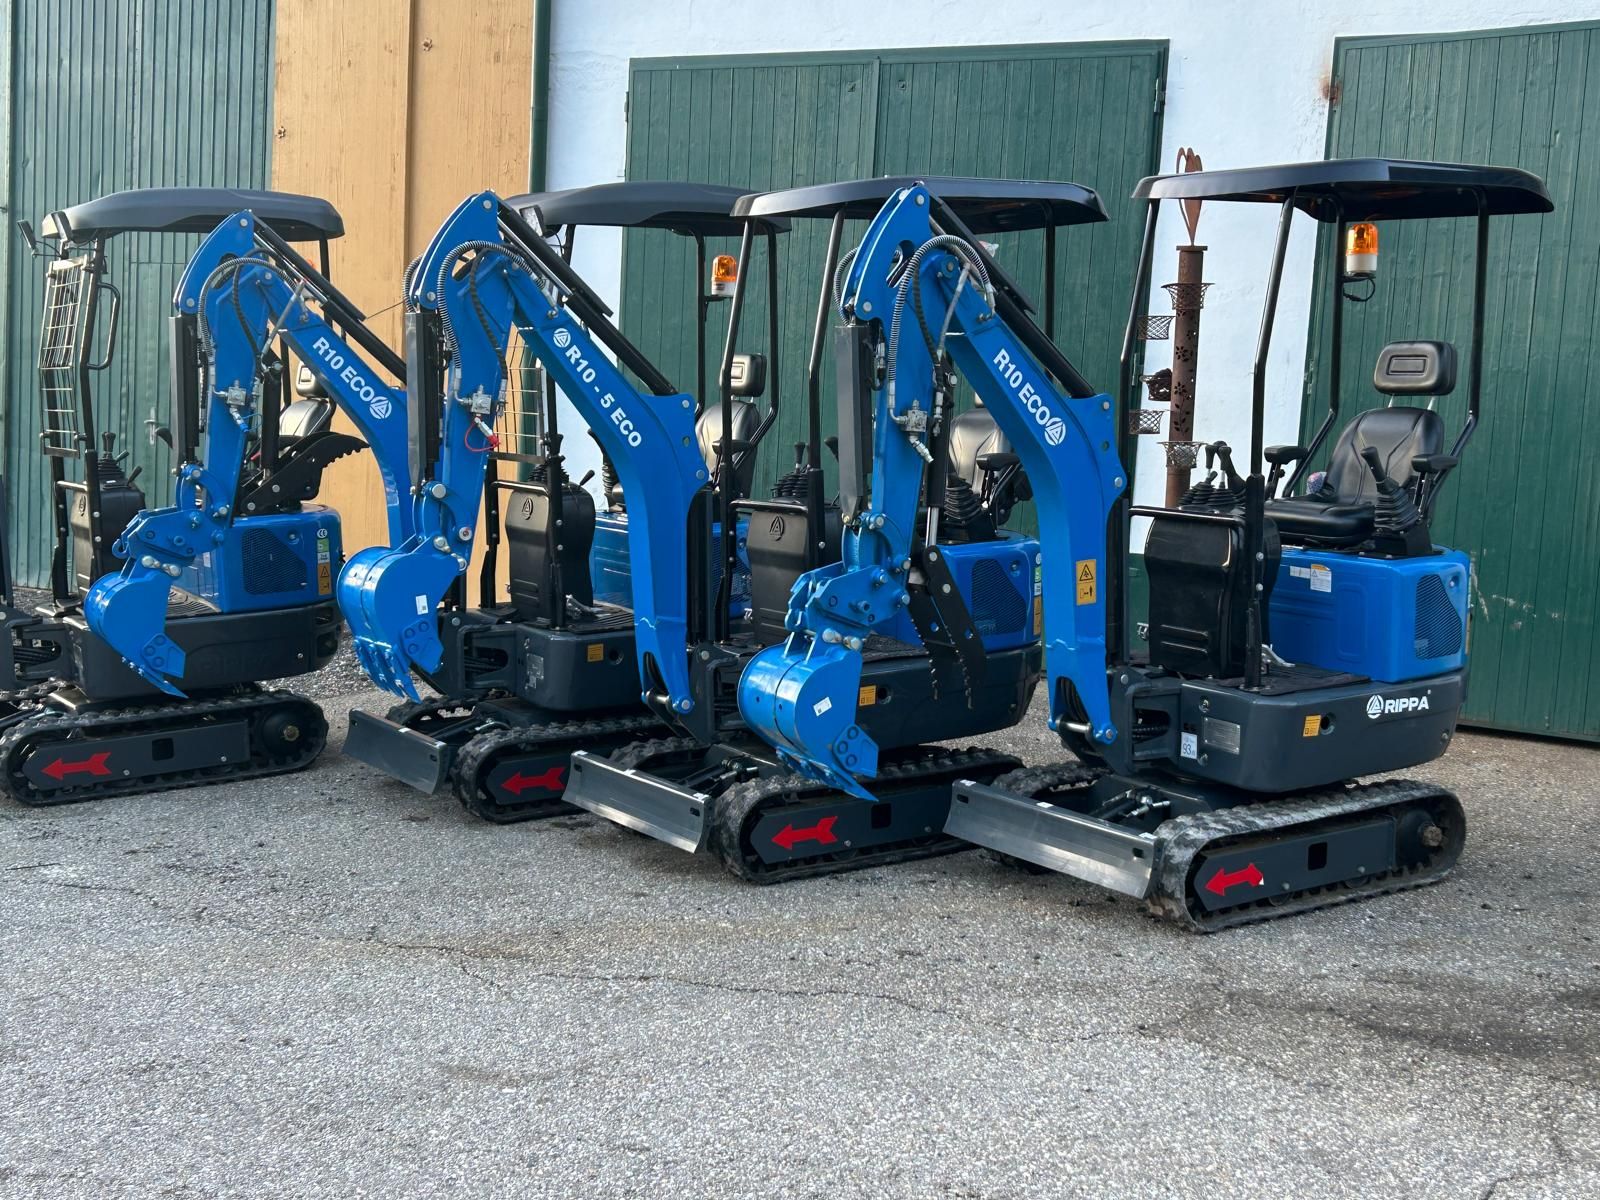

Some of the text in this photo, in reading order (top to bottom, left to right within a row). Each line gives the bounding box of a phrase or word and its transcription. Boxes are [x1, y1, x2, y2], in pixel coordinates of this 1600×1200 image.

[312, 336, 375, 402] R10 ECO
[565, 345, 596, 383] R10
[600, 393, 615, 408] 5
[610, 407, 642, 447] ECO
[993, 348, 1051, 425] R10 ECO
[1384, 696, 1429, 714] RIPPA
